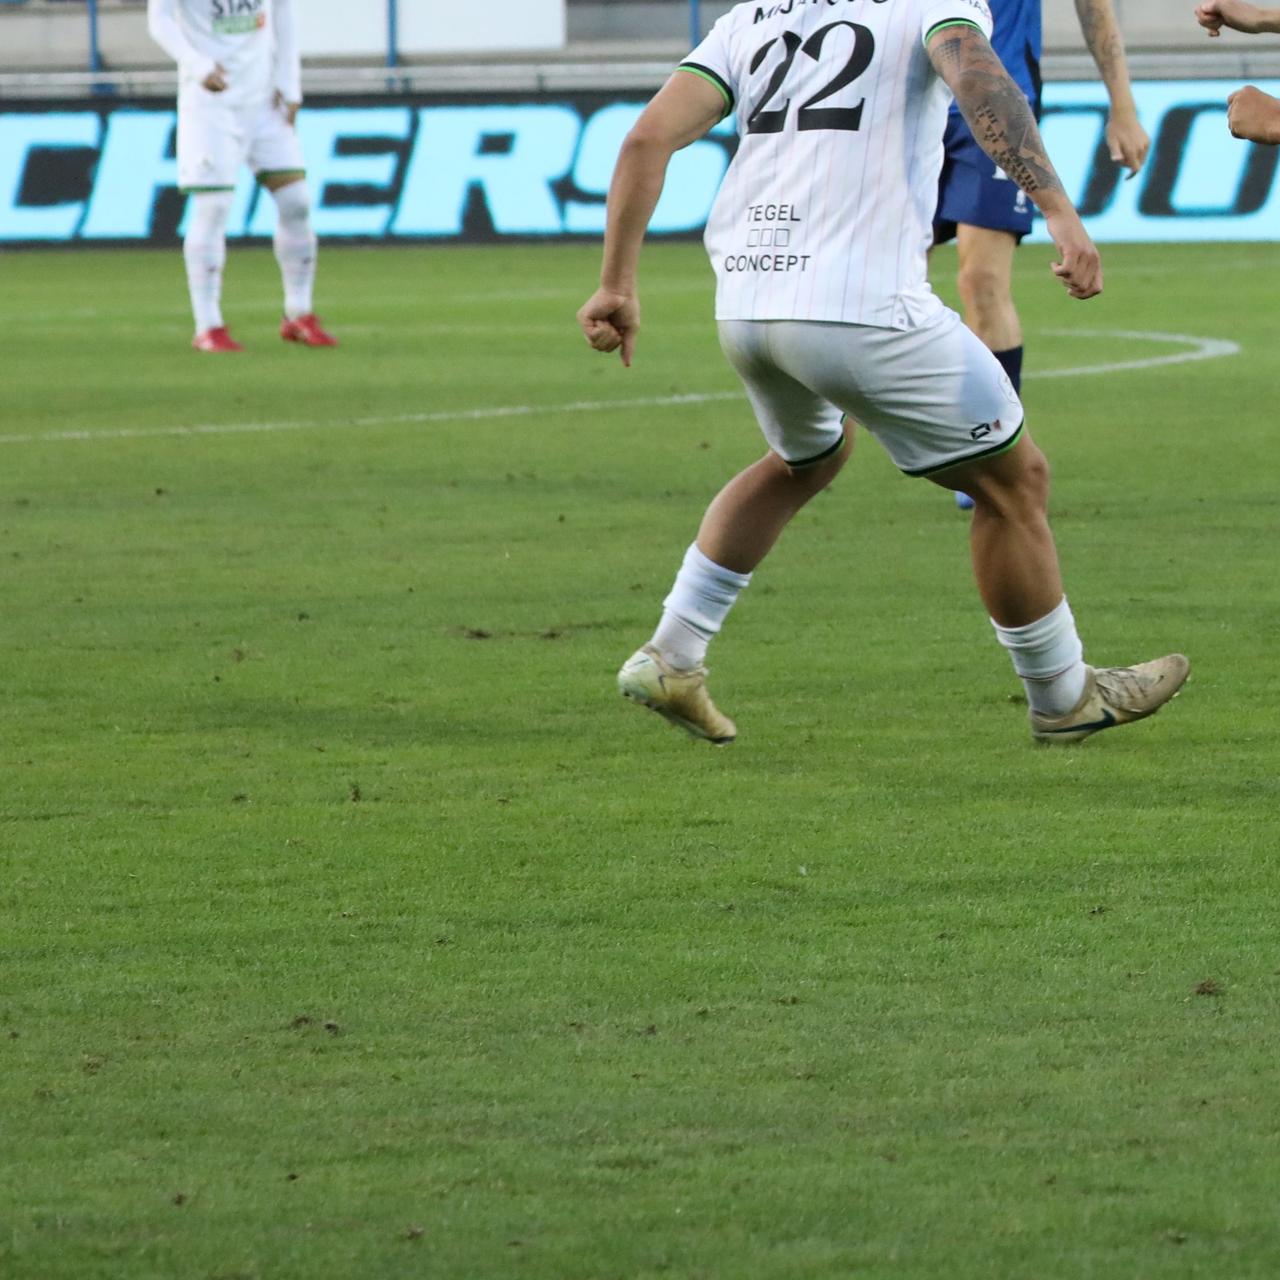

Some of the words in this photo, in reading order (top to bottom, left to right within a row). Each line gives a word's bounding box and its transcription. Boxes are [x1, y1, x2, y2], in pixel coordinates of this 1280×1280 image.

[746, 20, 875, 135] 22
[747, 204, 803, 222] TEGEL
[723, 254, 812, 273] CONCEPT
